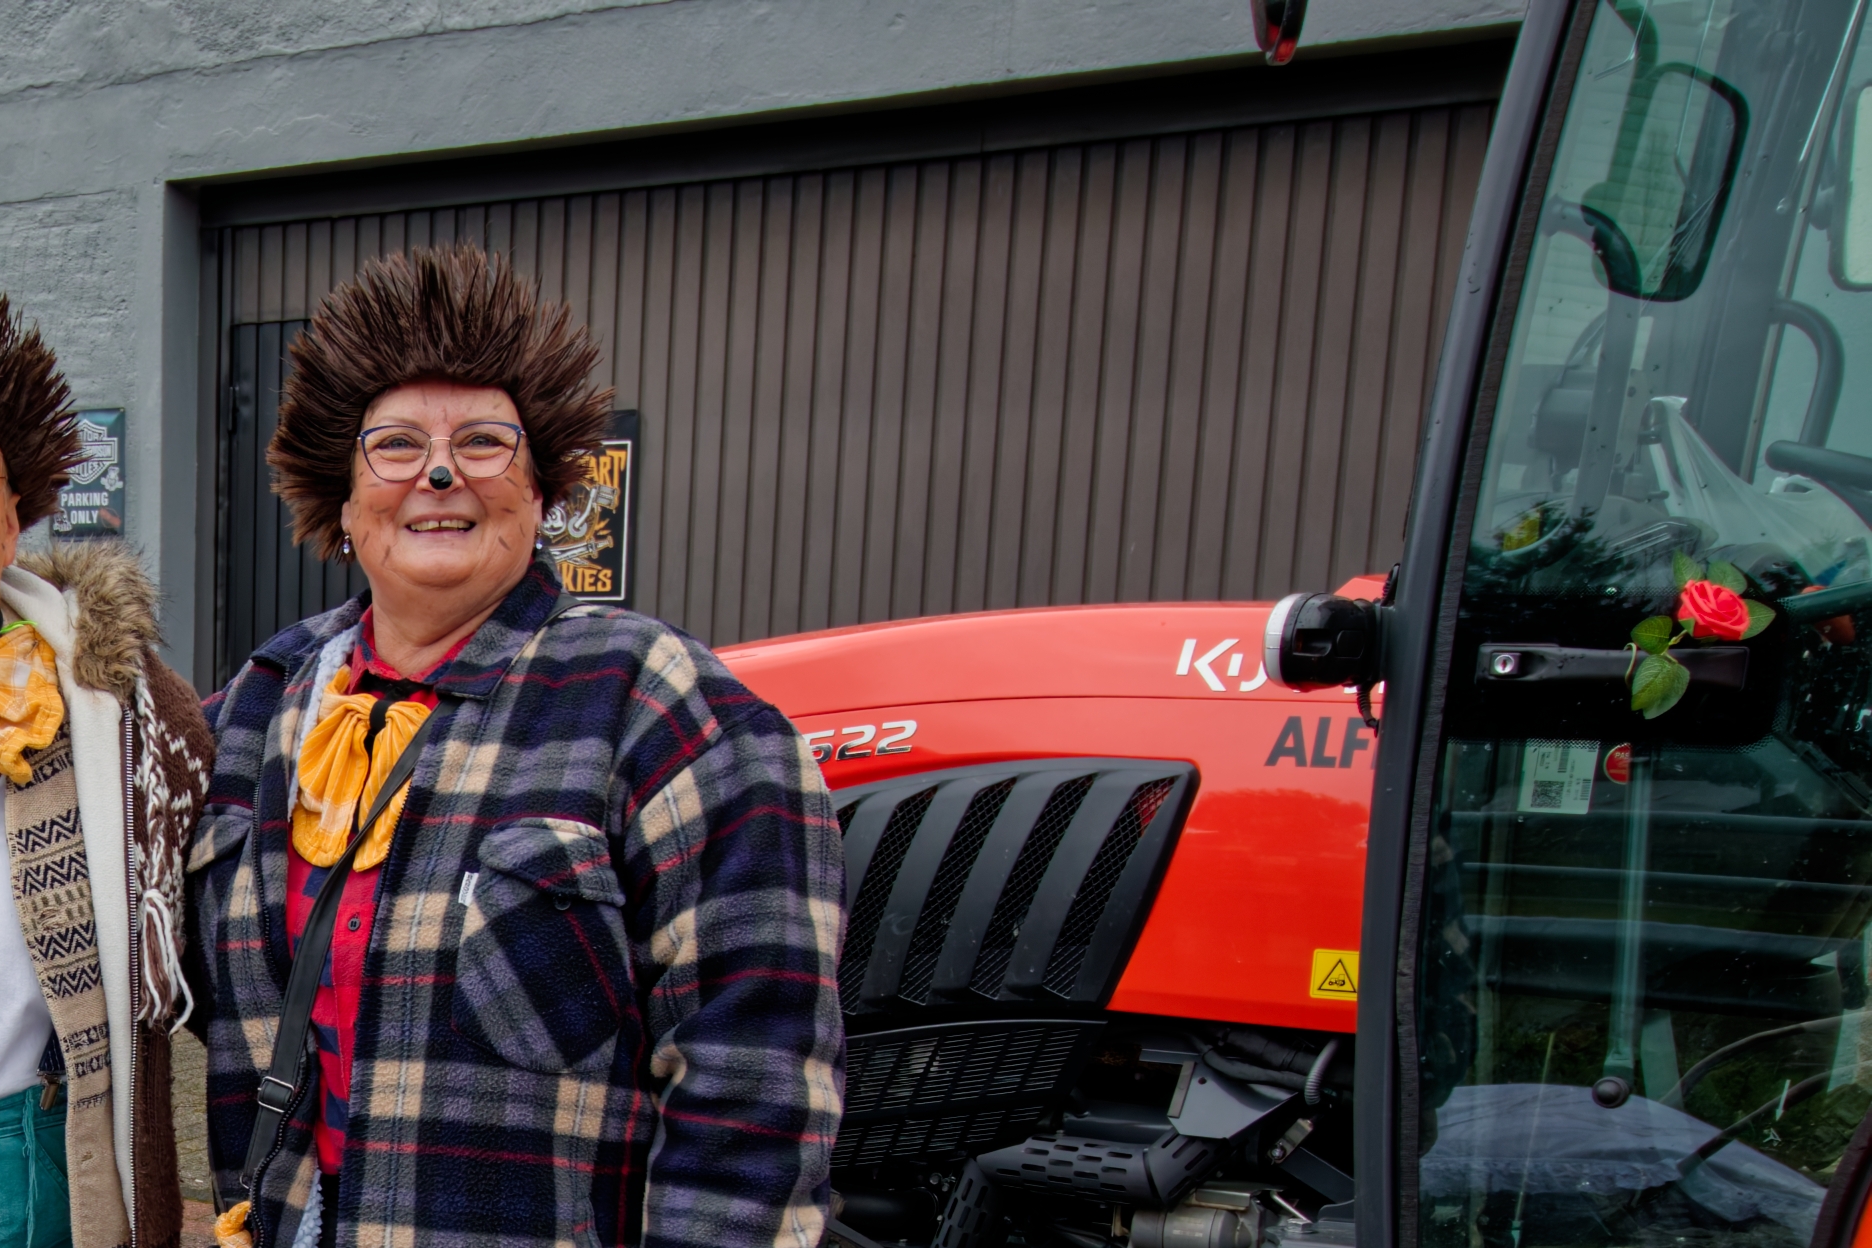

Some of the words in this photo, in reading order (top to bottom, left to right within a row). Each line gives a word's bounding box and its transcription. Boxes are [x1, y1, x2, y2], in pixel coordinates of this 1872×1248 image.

[60, 492, 109, 507] PARKING
[70, 510, 99, 524] ONLY
[1264, 716, 1377, 769] ALF
